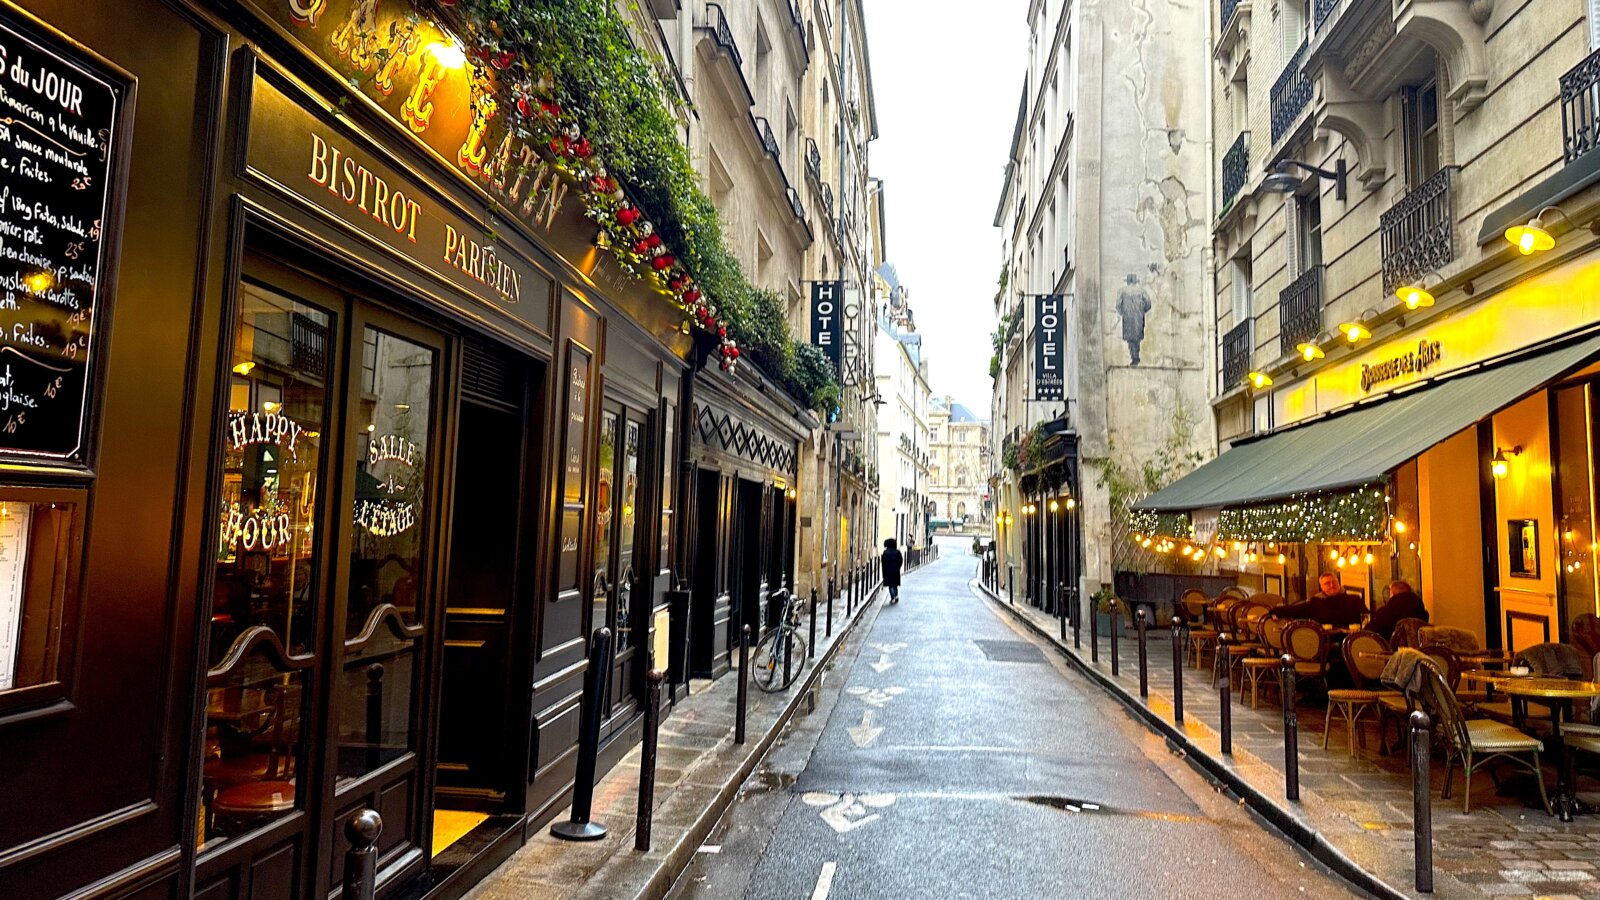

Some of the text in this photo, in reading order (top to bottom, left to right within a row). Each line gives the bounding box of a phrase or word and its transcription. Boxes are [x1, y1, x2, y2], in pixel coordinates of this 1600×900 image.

[10, 55, 29, 88] du
[32, 67, 82, 115] JOUR
[308, 132, 423, 244] BISTROT
[443, 223, 522, 304] PARISIEN
[64, 241, 85, 260] 23€
[13, 322, 50, 349] Frites.
[817, 286, 834, 358] HOTE
[1041, 300, 1058, 370] HOTEL
[61, 335, 86, 359] 19€
[843, 303, 860, 386] CINEMA
[0, 386, 38, 411] glaise.
[43, 376, 63, 399] 10€
[2, 411, 26, 434] 10€
[229, 412, 302, 452] HAPPY
[369, 434, 416, 466] SALLE
[222, 509, 292, 551] HOUR
